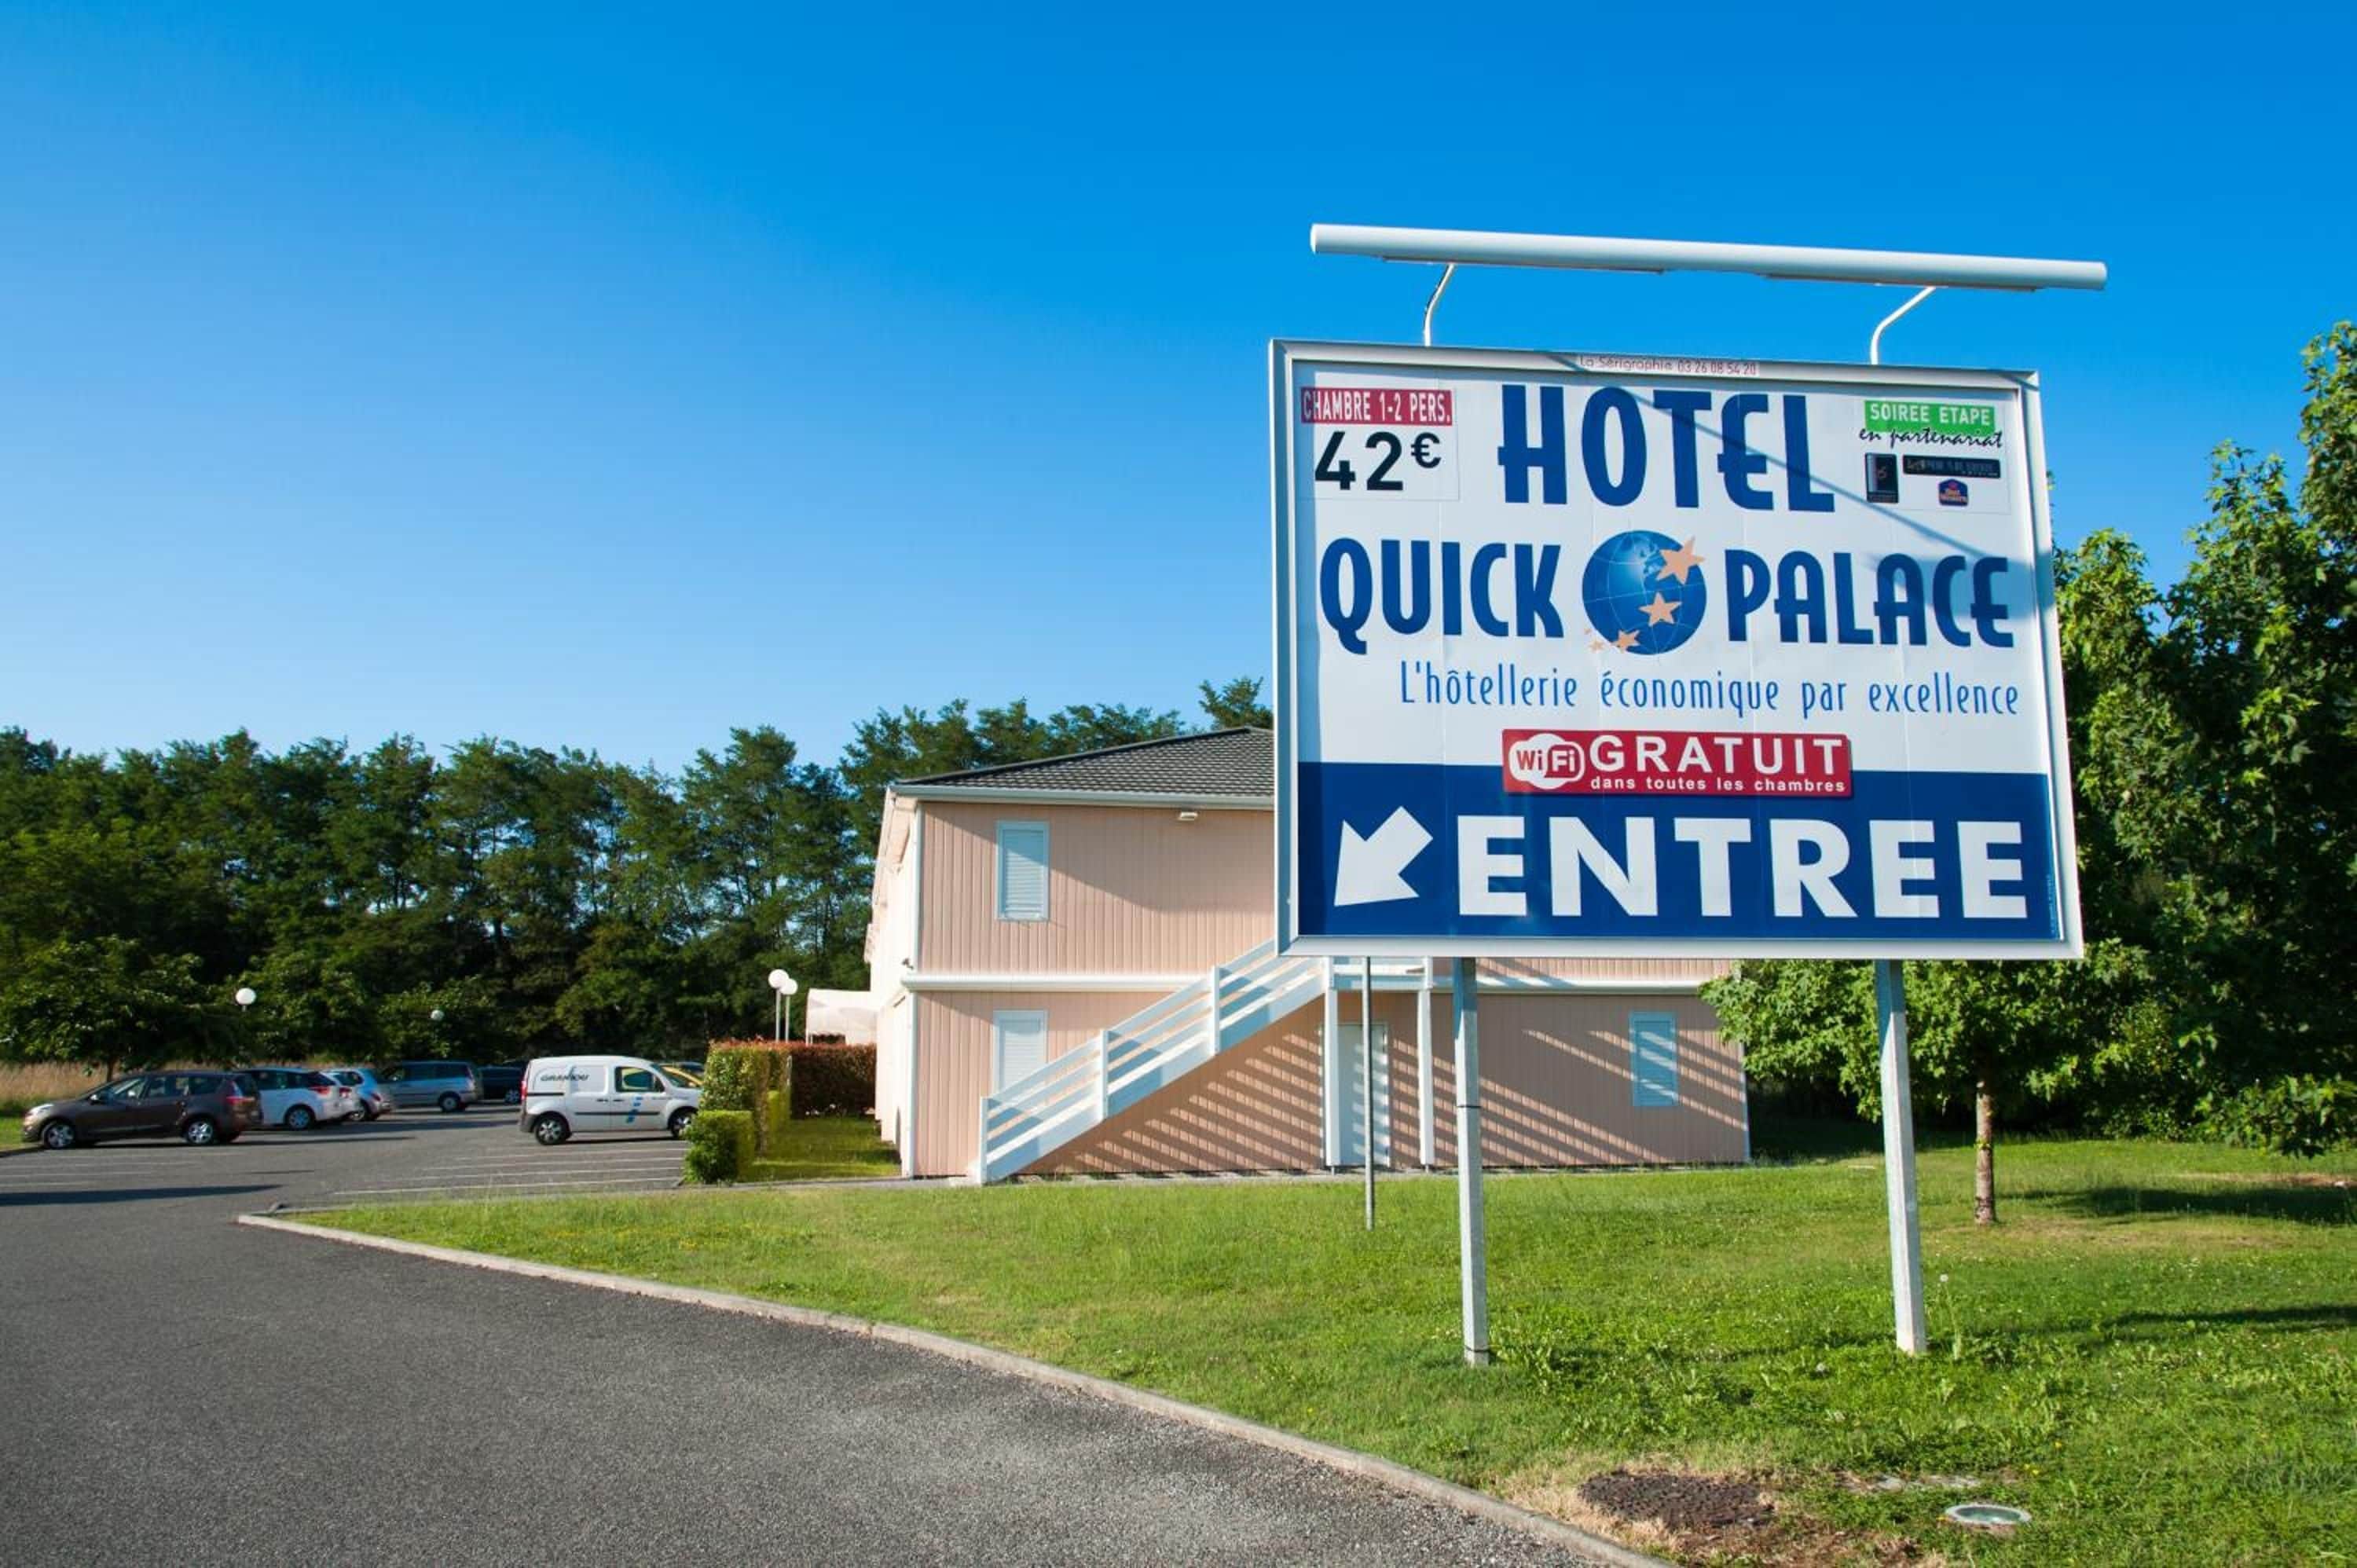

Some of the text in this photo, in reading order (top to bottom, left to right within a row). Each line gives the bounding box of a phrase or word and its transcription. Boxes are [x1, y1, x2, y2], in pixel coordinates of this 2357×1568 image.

[1303, 390, 1451, 423] CHAMBRE 1-2 PERS.
[1870, 403, 1991, 426] SOIREE ETAPE
[1497, 384, 1835, 512] HOTEL
[1859, 427, 2003, 449] en partenariat
[1320, 537, 2014, 655] QUICK PALACE
[1400, 661, 2018, 719] L'hôtellerie économique par excellence
[1589, 735, 1842, 775] GRATUIT
[1590, 776, 1846, 793] dans toutes les chambres
[1457, 815, 2028, 918] ENTREE
